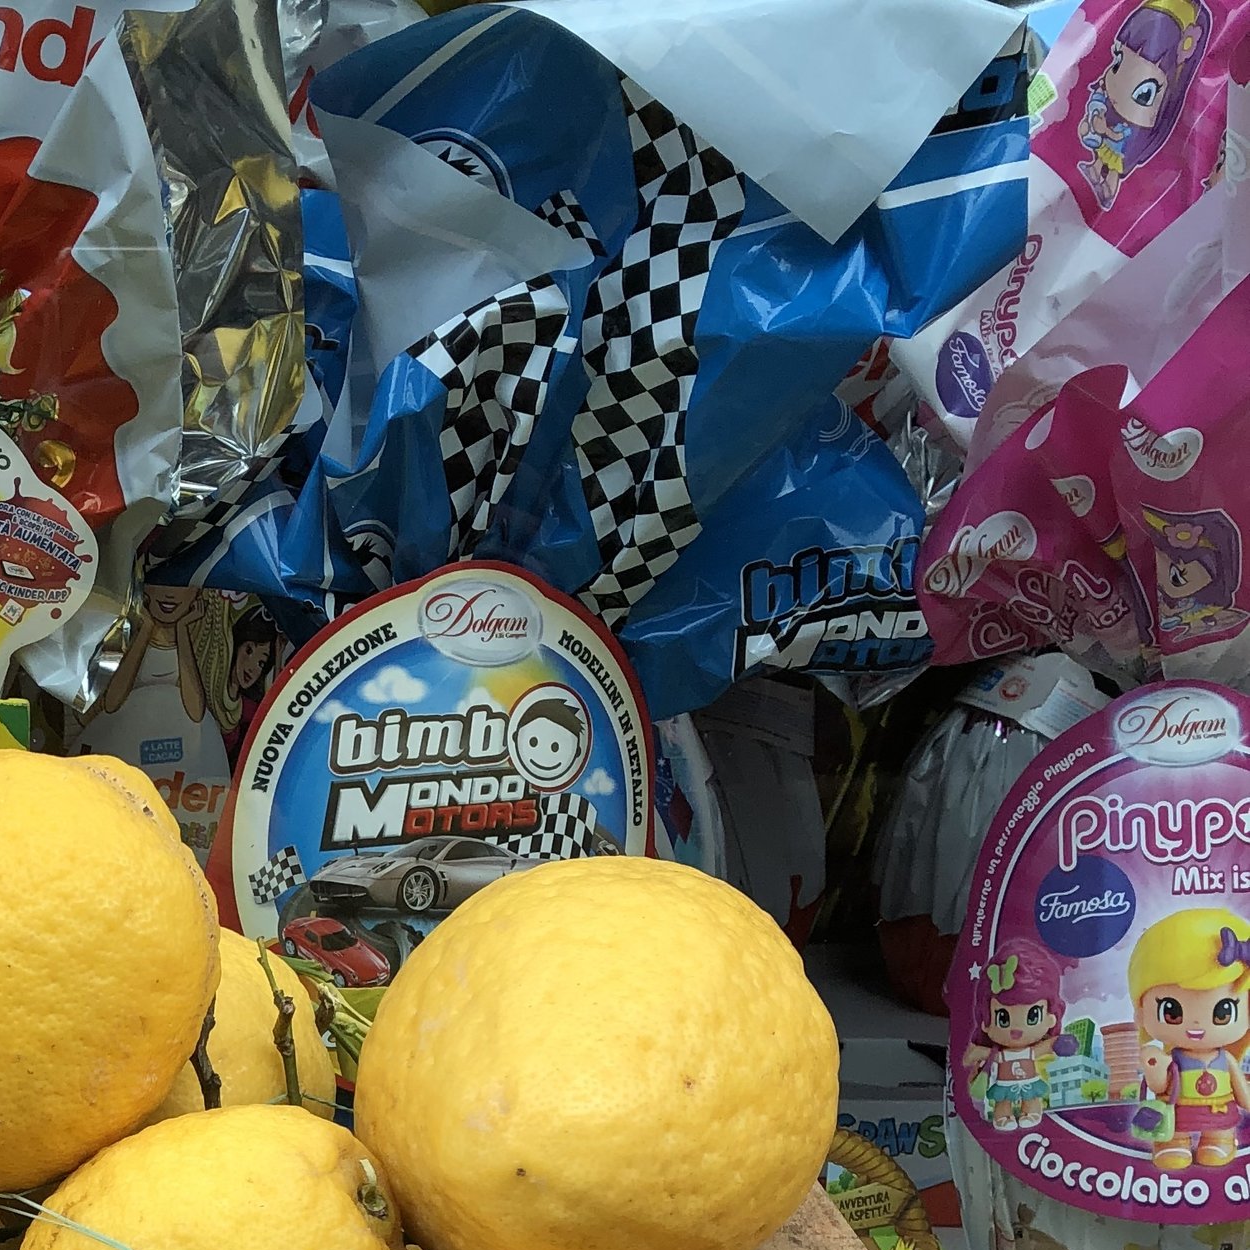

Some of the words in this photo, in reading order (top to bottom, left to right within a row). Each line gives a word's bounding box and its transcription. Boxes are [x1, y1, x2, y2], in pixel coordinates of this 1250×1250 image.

[16, 507, 32, 519] CON
[32, 513, 43, 524] LE
[19, 517, 43, 533] SCOPRI
[44, 528, 54, 538] LA
[13, 529, 82, 571] AUMENTATA
[7, 585, 47, 600] KINDER
[48, 590, 68, 601] APP
[425, 589, 528, 642] Dolgam
[745, 611, 929, 669] MOND
[558, 630, 625, 712] MODELLINI
[251, 722, 294, 793] NUOVA
[287, 622, 397, 718] COLLEZIONE
[618, 709, 633, 736] IN
[1118, 696, 1226, 748] Dolgam
[625, 735, 643, 826] METALLO
[987, 853, 1001, 875] un
[995, 781, 1045, 854] personaggio
[1039, 884, 1131, 924] Famosa
[1173, 865, 1224, 893] Mix
[1018, 1132, 1210, 1205] Cioccolato
